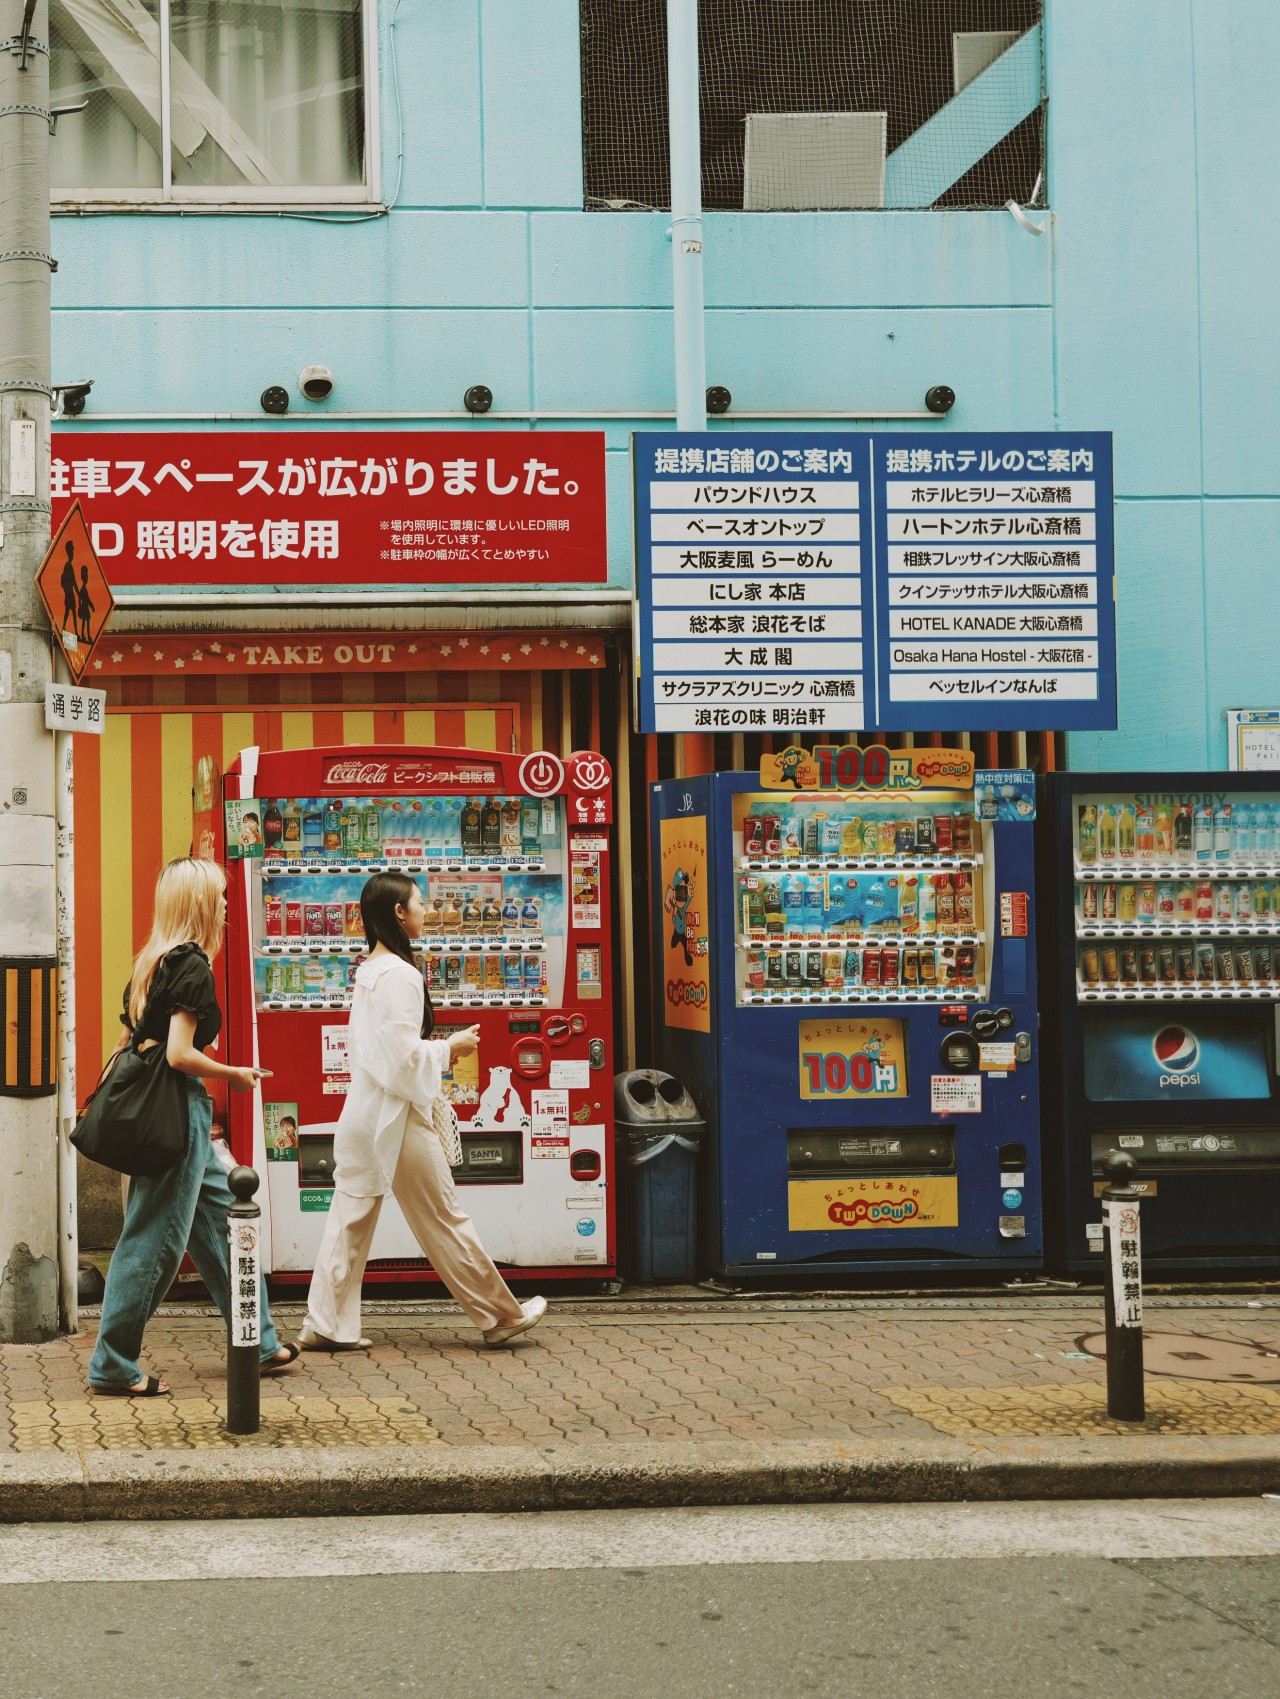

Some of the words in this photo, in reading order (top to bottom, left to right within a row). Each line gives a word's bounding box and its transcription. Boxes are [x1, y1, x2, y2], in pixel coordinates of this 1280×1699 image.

[655, 448, 852, 474] 提携店舗のご案内
[886, 448, 1093, 473] 提携ホテルのご案内
[693, 486, 816, 504] パウンドハウス
[911, 487, 1071, 503] ホテルヒラリーズ心斎橋
[379, 519, 570, 532] ※場内照明に環境に優しいLED照明
[686, 518, 826, 536] ベースオントップ
[902, 517, 1081, 536] ハートンホテル心斎橋
[136, 518, 339, 560] 照明を使用
[390, 533, 487, 545] を使用しています。
[380, 549, 550, 561] ※駐車枠の幅が広くてとめやすい
[680, 551, 754, 569] 大阪麦風
[762, 551, 833, 568] らーめん
[903, 551, 1080, 567] 相鉄フレッサイン大阪心斎橋
[710, 583, 762, 601] にし家
[769, 583, 806, 601] 本店
[898, 583, 1088, 599] クインテッサホテル大阪心斎橋
[689, 615, 745, 634] 総本家
[752, 615, 826, 633] 浪花そば
[901, 617, 950, 631] HOTEL
[953, 617, 1016, 630] KANADE
[1020, 616, 1083, 631] 大阪心斎橋
[243, 645, 324, 665] TAKE
[333, 644, 395, 664] OUT
[894, 649, 938, 663] Osaka
[942, 649, 978, 662] Hana
[981, 649, 1026, 662] Hostel
[1037, 648, 1084, 663] 大阪花宿
[662, 680, 804, 697] サクラアズクリニック
[809, 680, 855, 697] 心斎橋
[929, 678, 1058, 694] ベッセルインなんば
[52, 692, 101, 722] 通学路
[695, 708, 767, 726] 浪花の味
[772, 708, 826, 726] 明治軒
[393, 770, 496, 784] ピークシフト自販機
[804, 1025, 892, 1042] ちょっとしあわせ
[324, 1036, 348, 1050] 1本無
[805, 1053, 896, 1091] 100円
[1159, 1072, 1201, 1088] pepsi
[471, 1150, 501, 1159] SANTA
[824, 1181, 920, 1202] ちょっとしあわせ
[834, 1204, 867, 1221] TWO
[872, 1203, 913, 1219] DOWN
[1120, 1239, 1141, 1322] 駐輪禁止
[238, 1257, 257, 1341] 駐輪禁止
